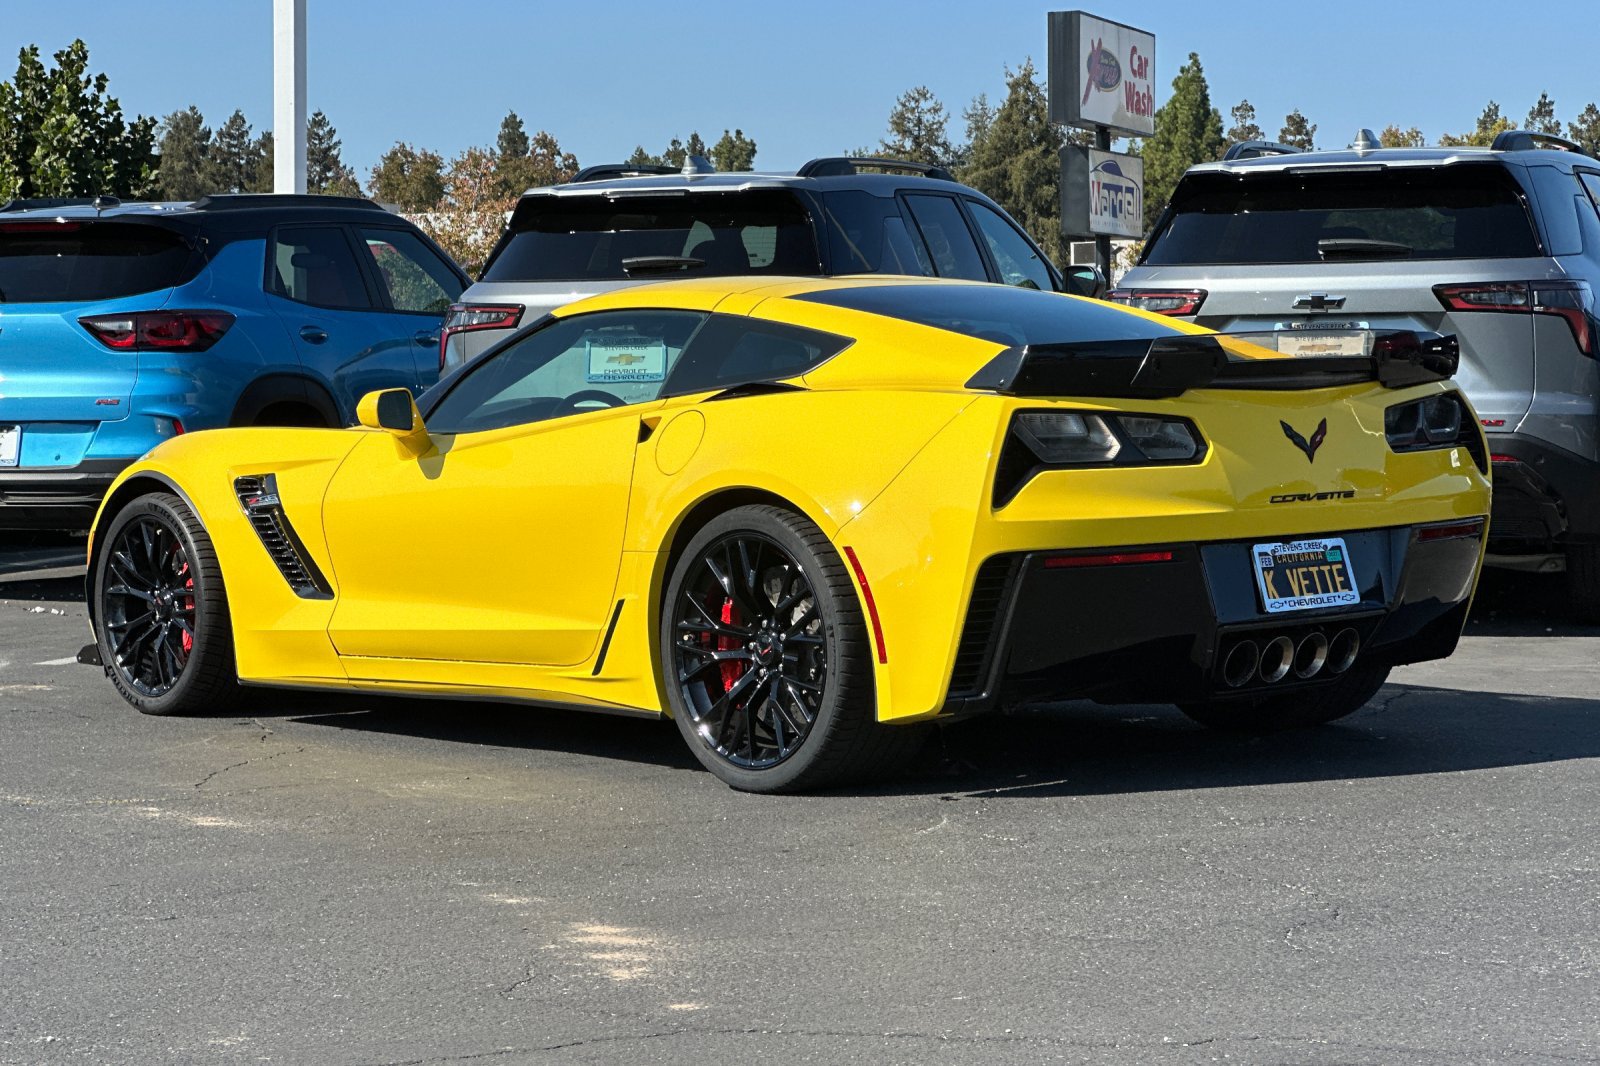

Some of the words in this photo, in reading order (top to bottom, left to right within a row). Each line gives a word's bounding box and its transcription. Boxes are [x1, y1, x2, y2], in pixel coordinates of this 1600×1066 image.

[1129, 45, 1148, 80] Car
[1125, 80, 1153, 118] Wash
[1091, 180, 1141, 221] Wardell
[1269, 490, 1354, 503] CORVETTE
[1274, 543, 1303, 553] STEVENS
[1304, 541, 1323, 550] CREEK
[1261, 557, 1272, 567] FEB
[1276, 552, 1323, 564] CALIFORNIA
[1264, 569, 1279, 599] K
[1286, 564, 1349, 597] VETTE
[1288, 595, 1337, 608] CHEVROLET
